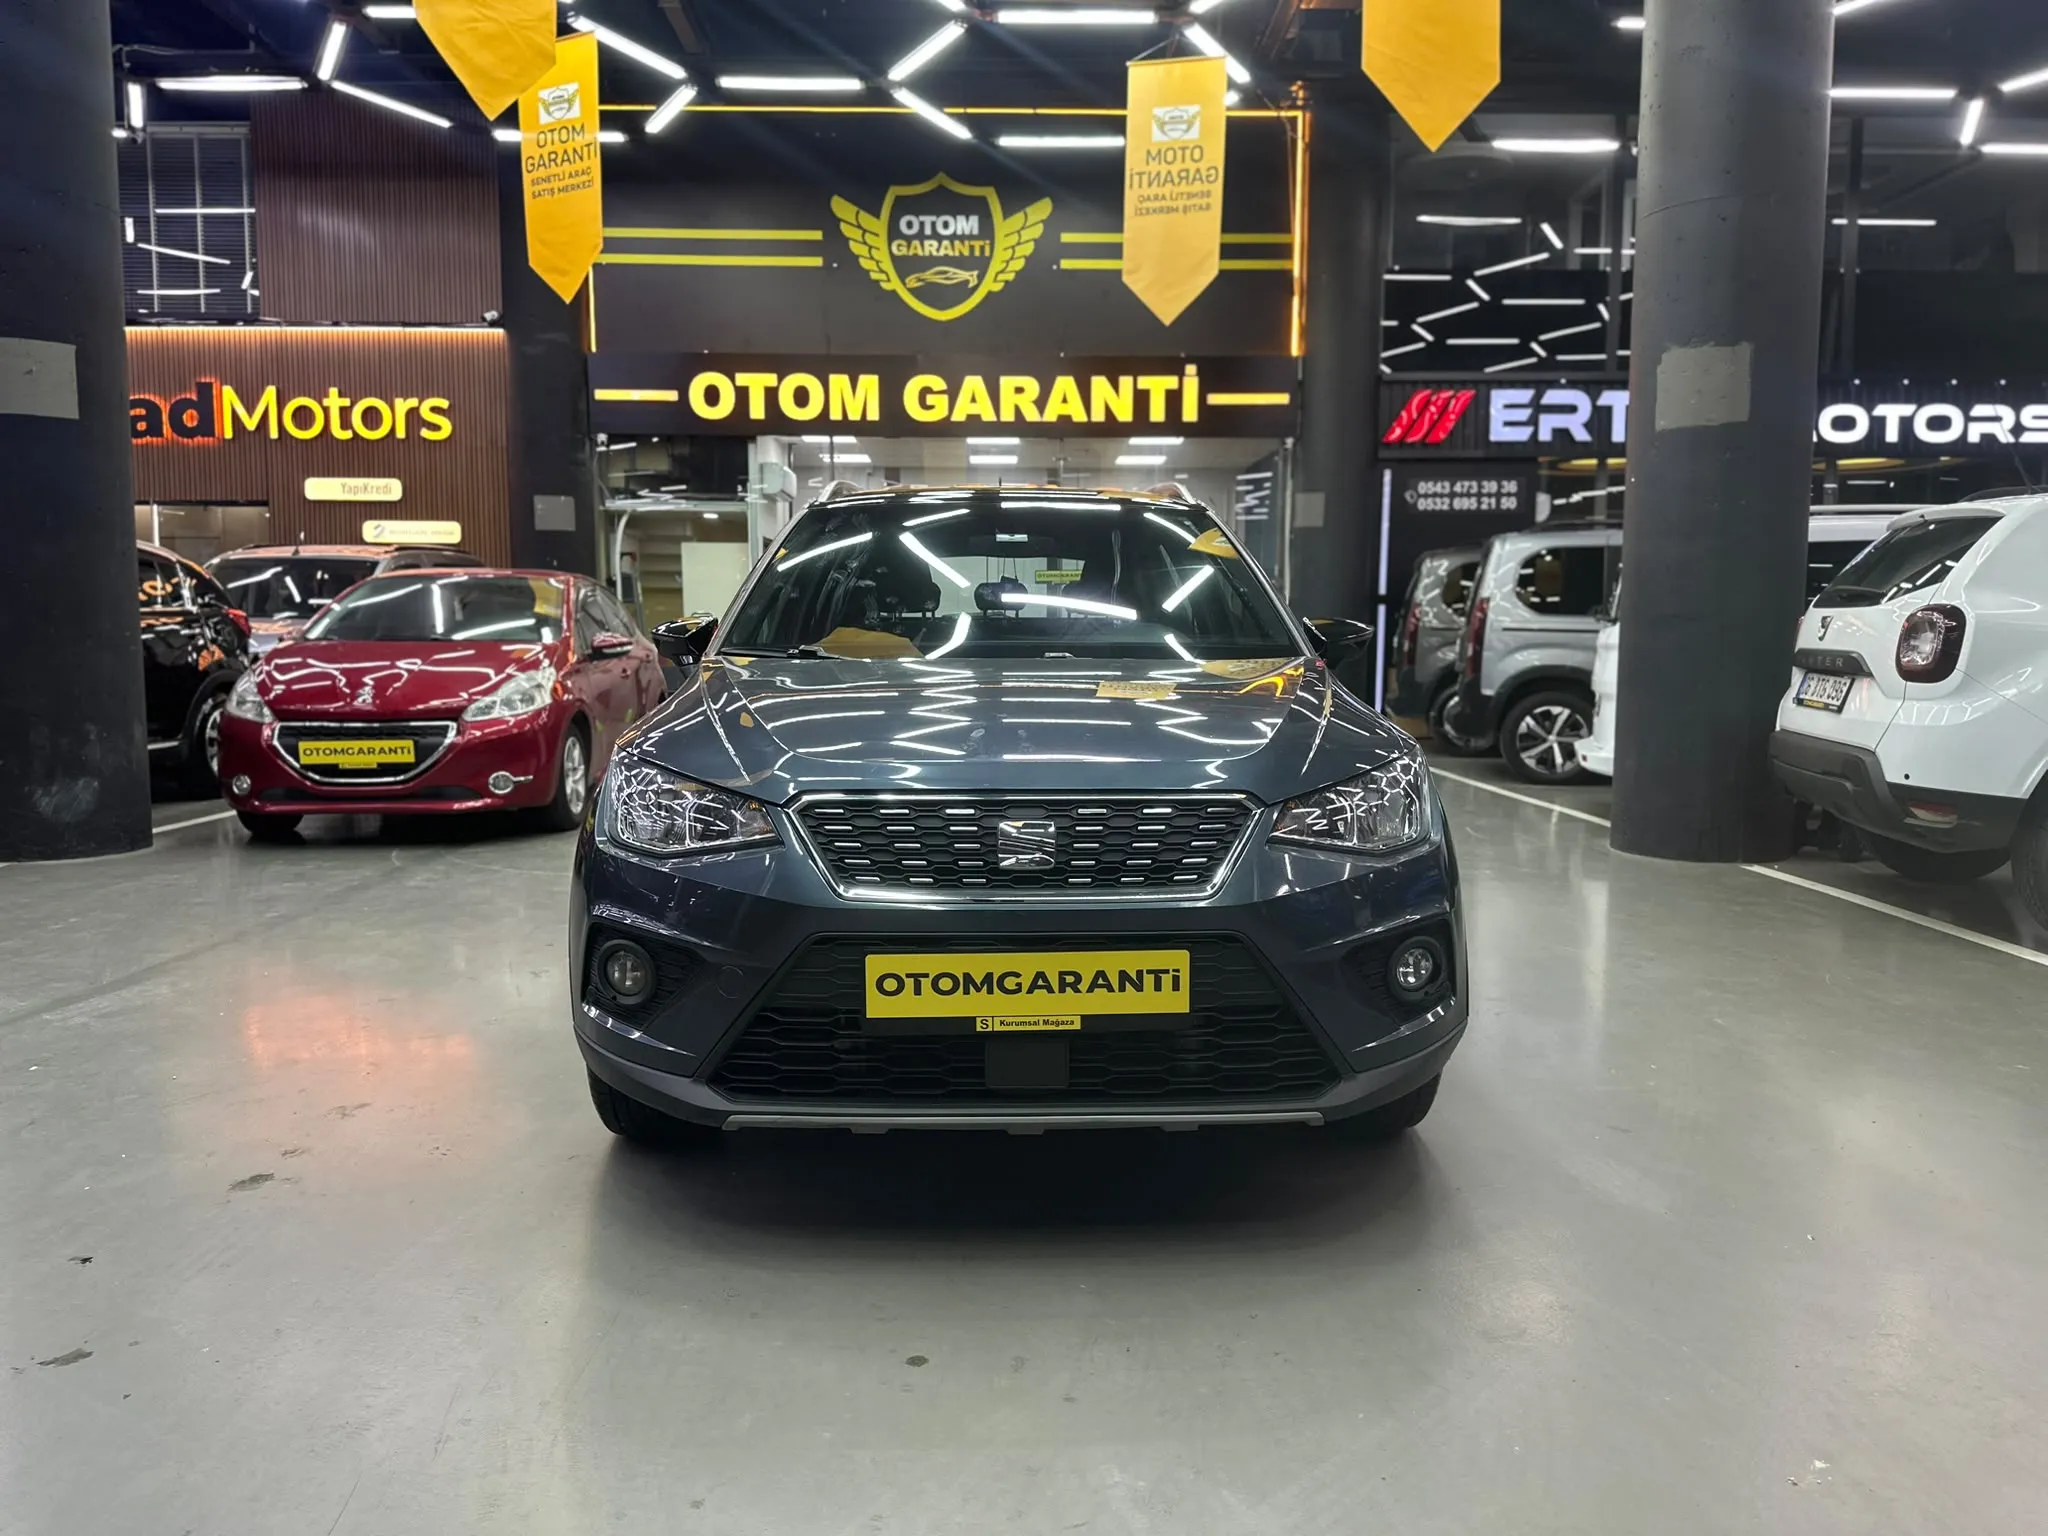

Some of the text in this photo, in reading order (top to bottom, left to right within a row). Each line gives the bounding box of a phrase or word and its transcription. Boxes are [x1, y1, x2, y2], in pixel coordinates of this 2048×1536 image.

[536, 123, 584, 148] OTOM
[568, 166, 592, 180] ARAÇ
[899, 214, 980, 236] OTOM
[688, 364, 1199, 423] OTOM GARANTİ
[1000, 1019, 1040, 1027] Kurumsal
[1042, 1018, 1075, 1028] Mağaza
